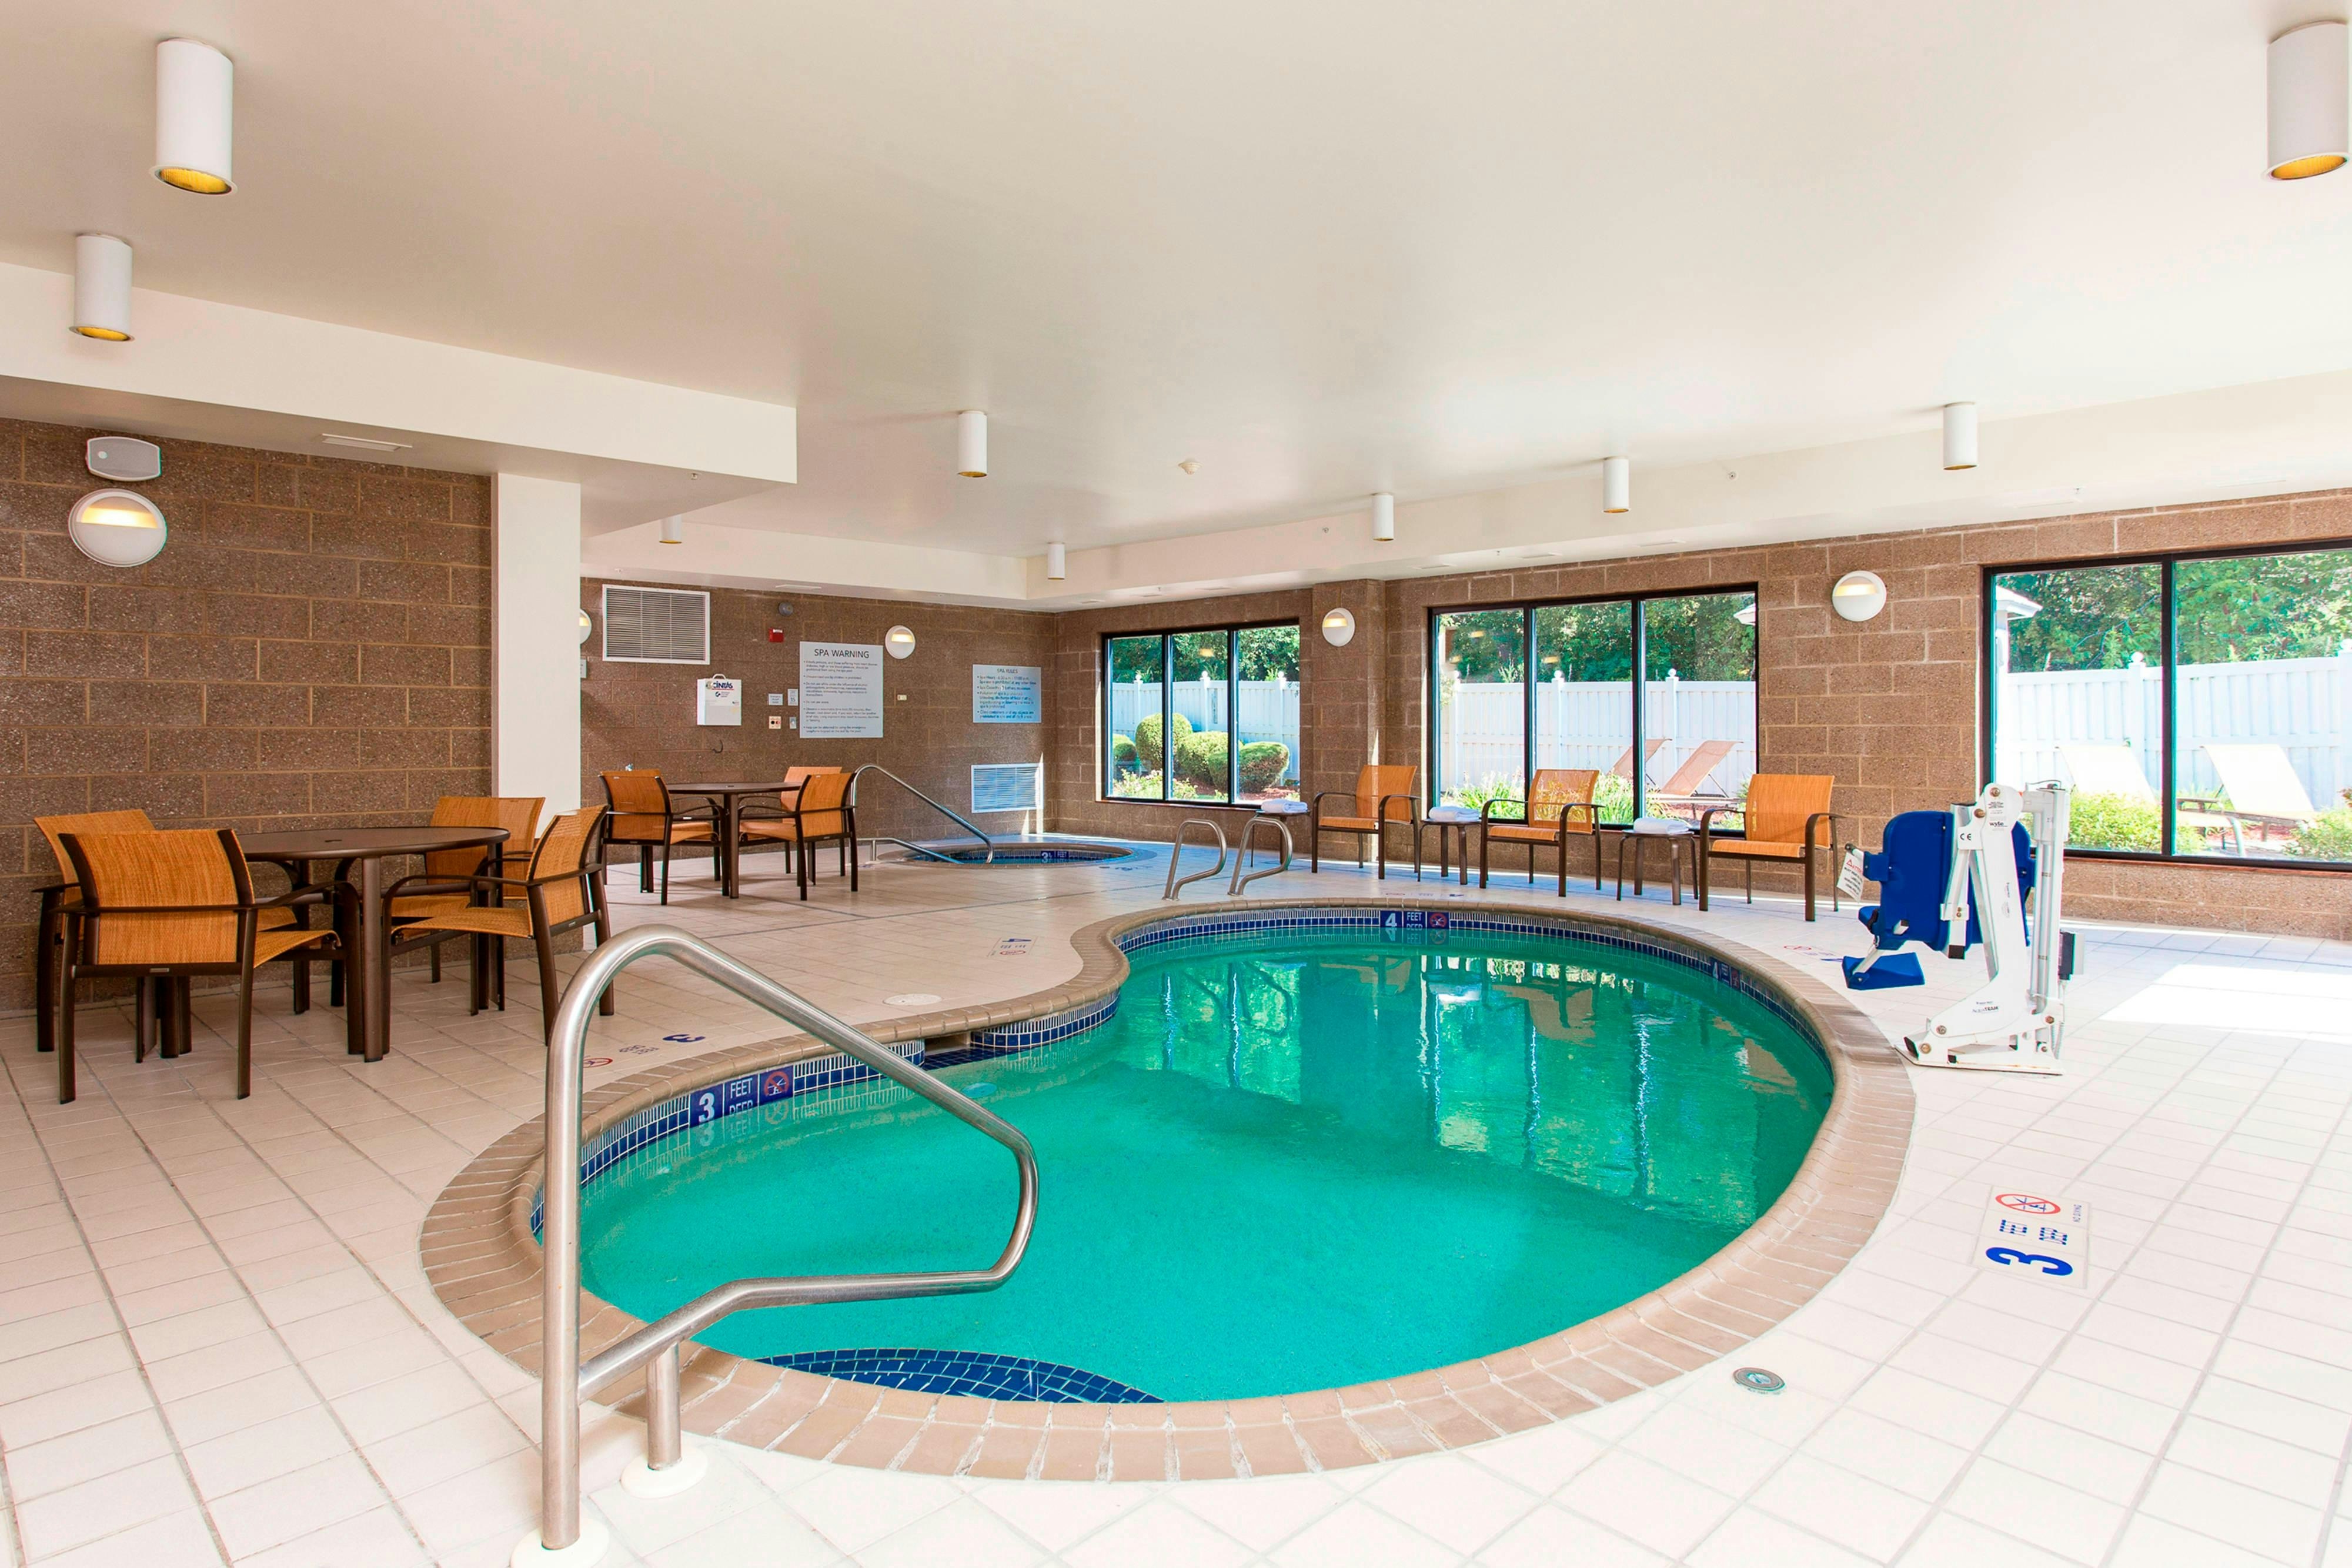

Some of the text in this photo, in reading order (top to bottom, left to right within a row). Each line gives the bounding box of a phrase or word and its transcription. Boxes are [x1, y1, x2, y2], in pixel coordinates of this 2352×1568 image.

[831, 650, 869, 658] WARNING
[1385, 912, 1397, 927] 4
[1407, 912, 1422, 921] FEET
[730, 1077, 753, 1099] FEET
[699, 1092, 714, 1122] 3
[1986, 1247, 2073, 1276] 3
